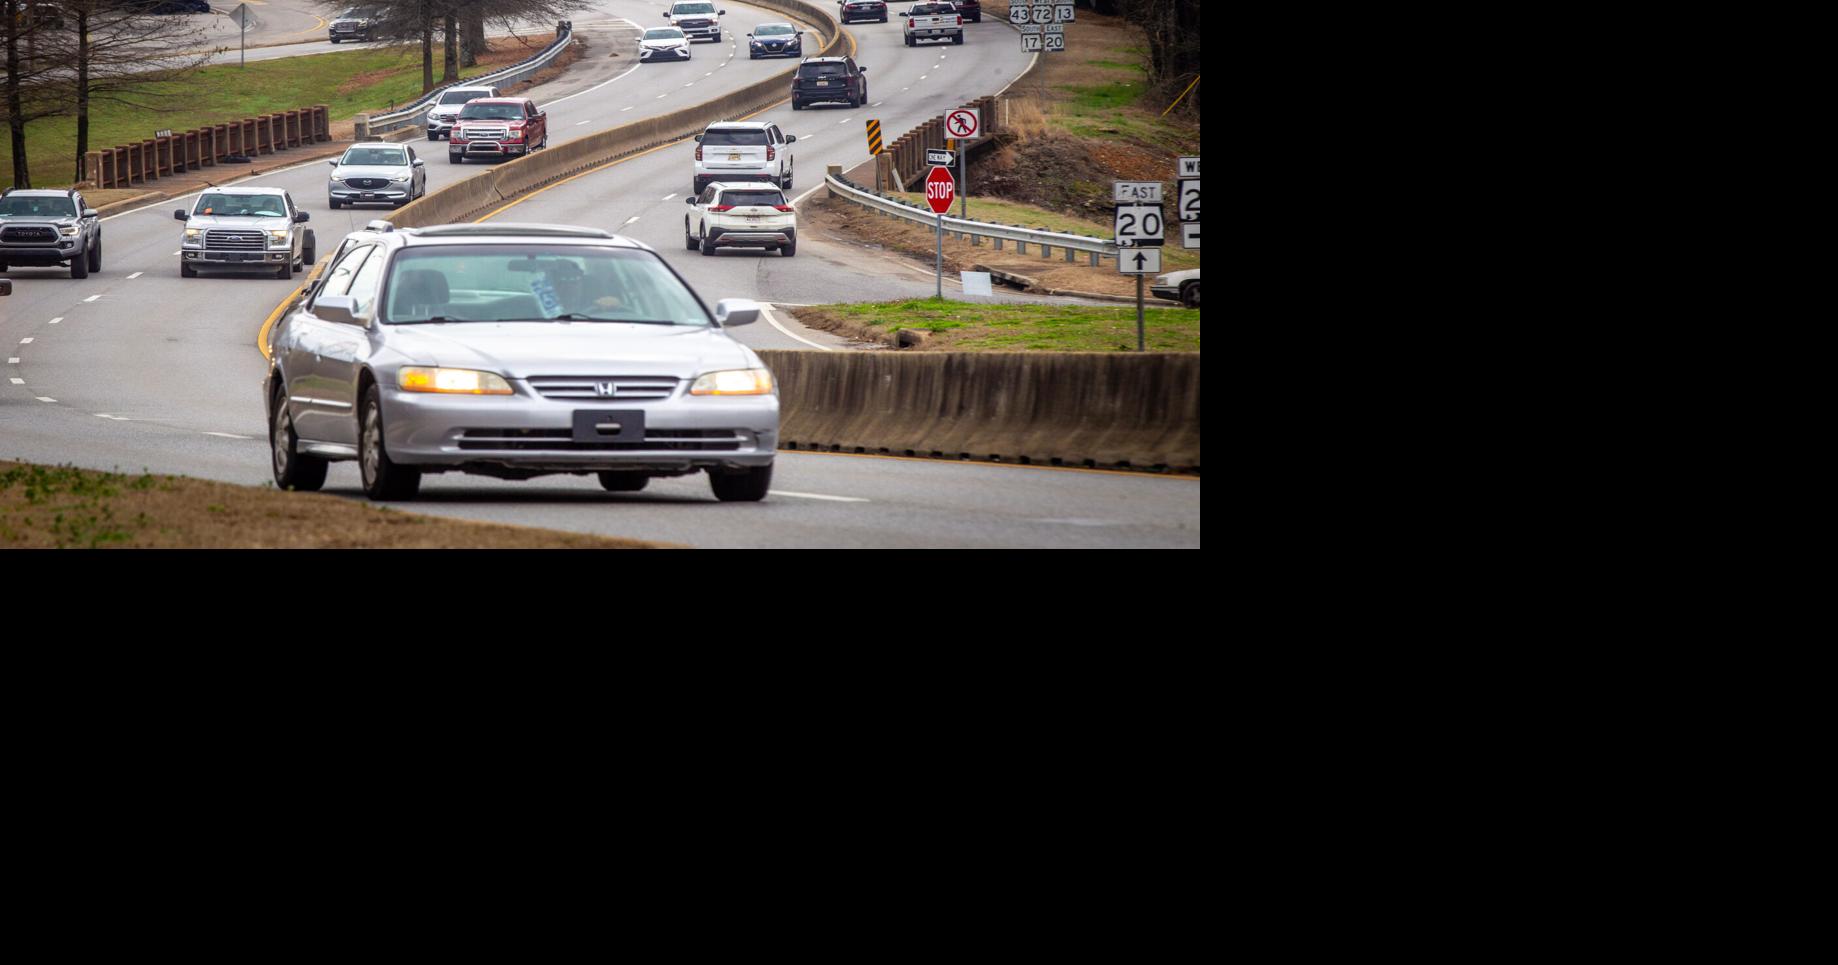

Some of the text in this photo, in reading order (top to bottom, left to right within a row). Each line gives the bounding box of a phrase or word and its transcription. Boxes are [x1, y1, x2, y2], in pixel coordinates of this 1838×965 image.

[1011, 9, 1028, 20] 43
[1035, 9, 1050, 20] 72
[1058, 8, 1071, 19] 13
[1024, 37, 1038, 48] 17
[1046, 36, 1062, 48] 20
[928, 182, 953, 199] STOP
[1119, 213, 1160, 236] 20
